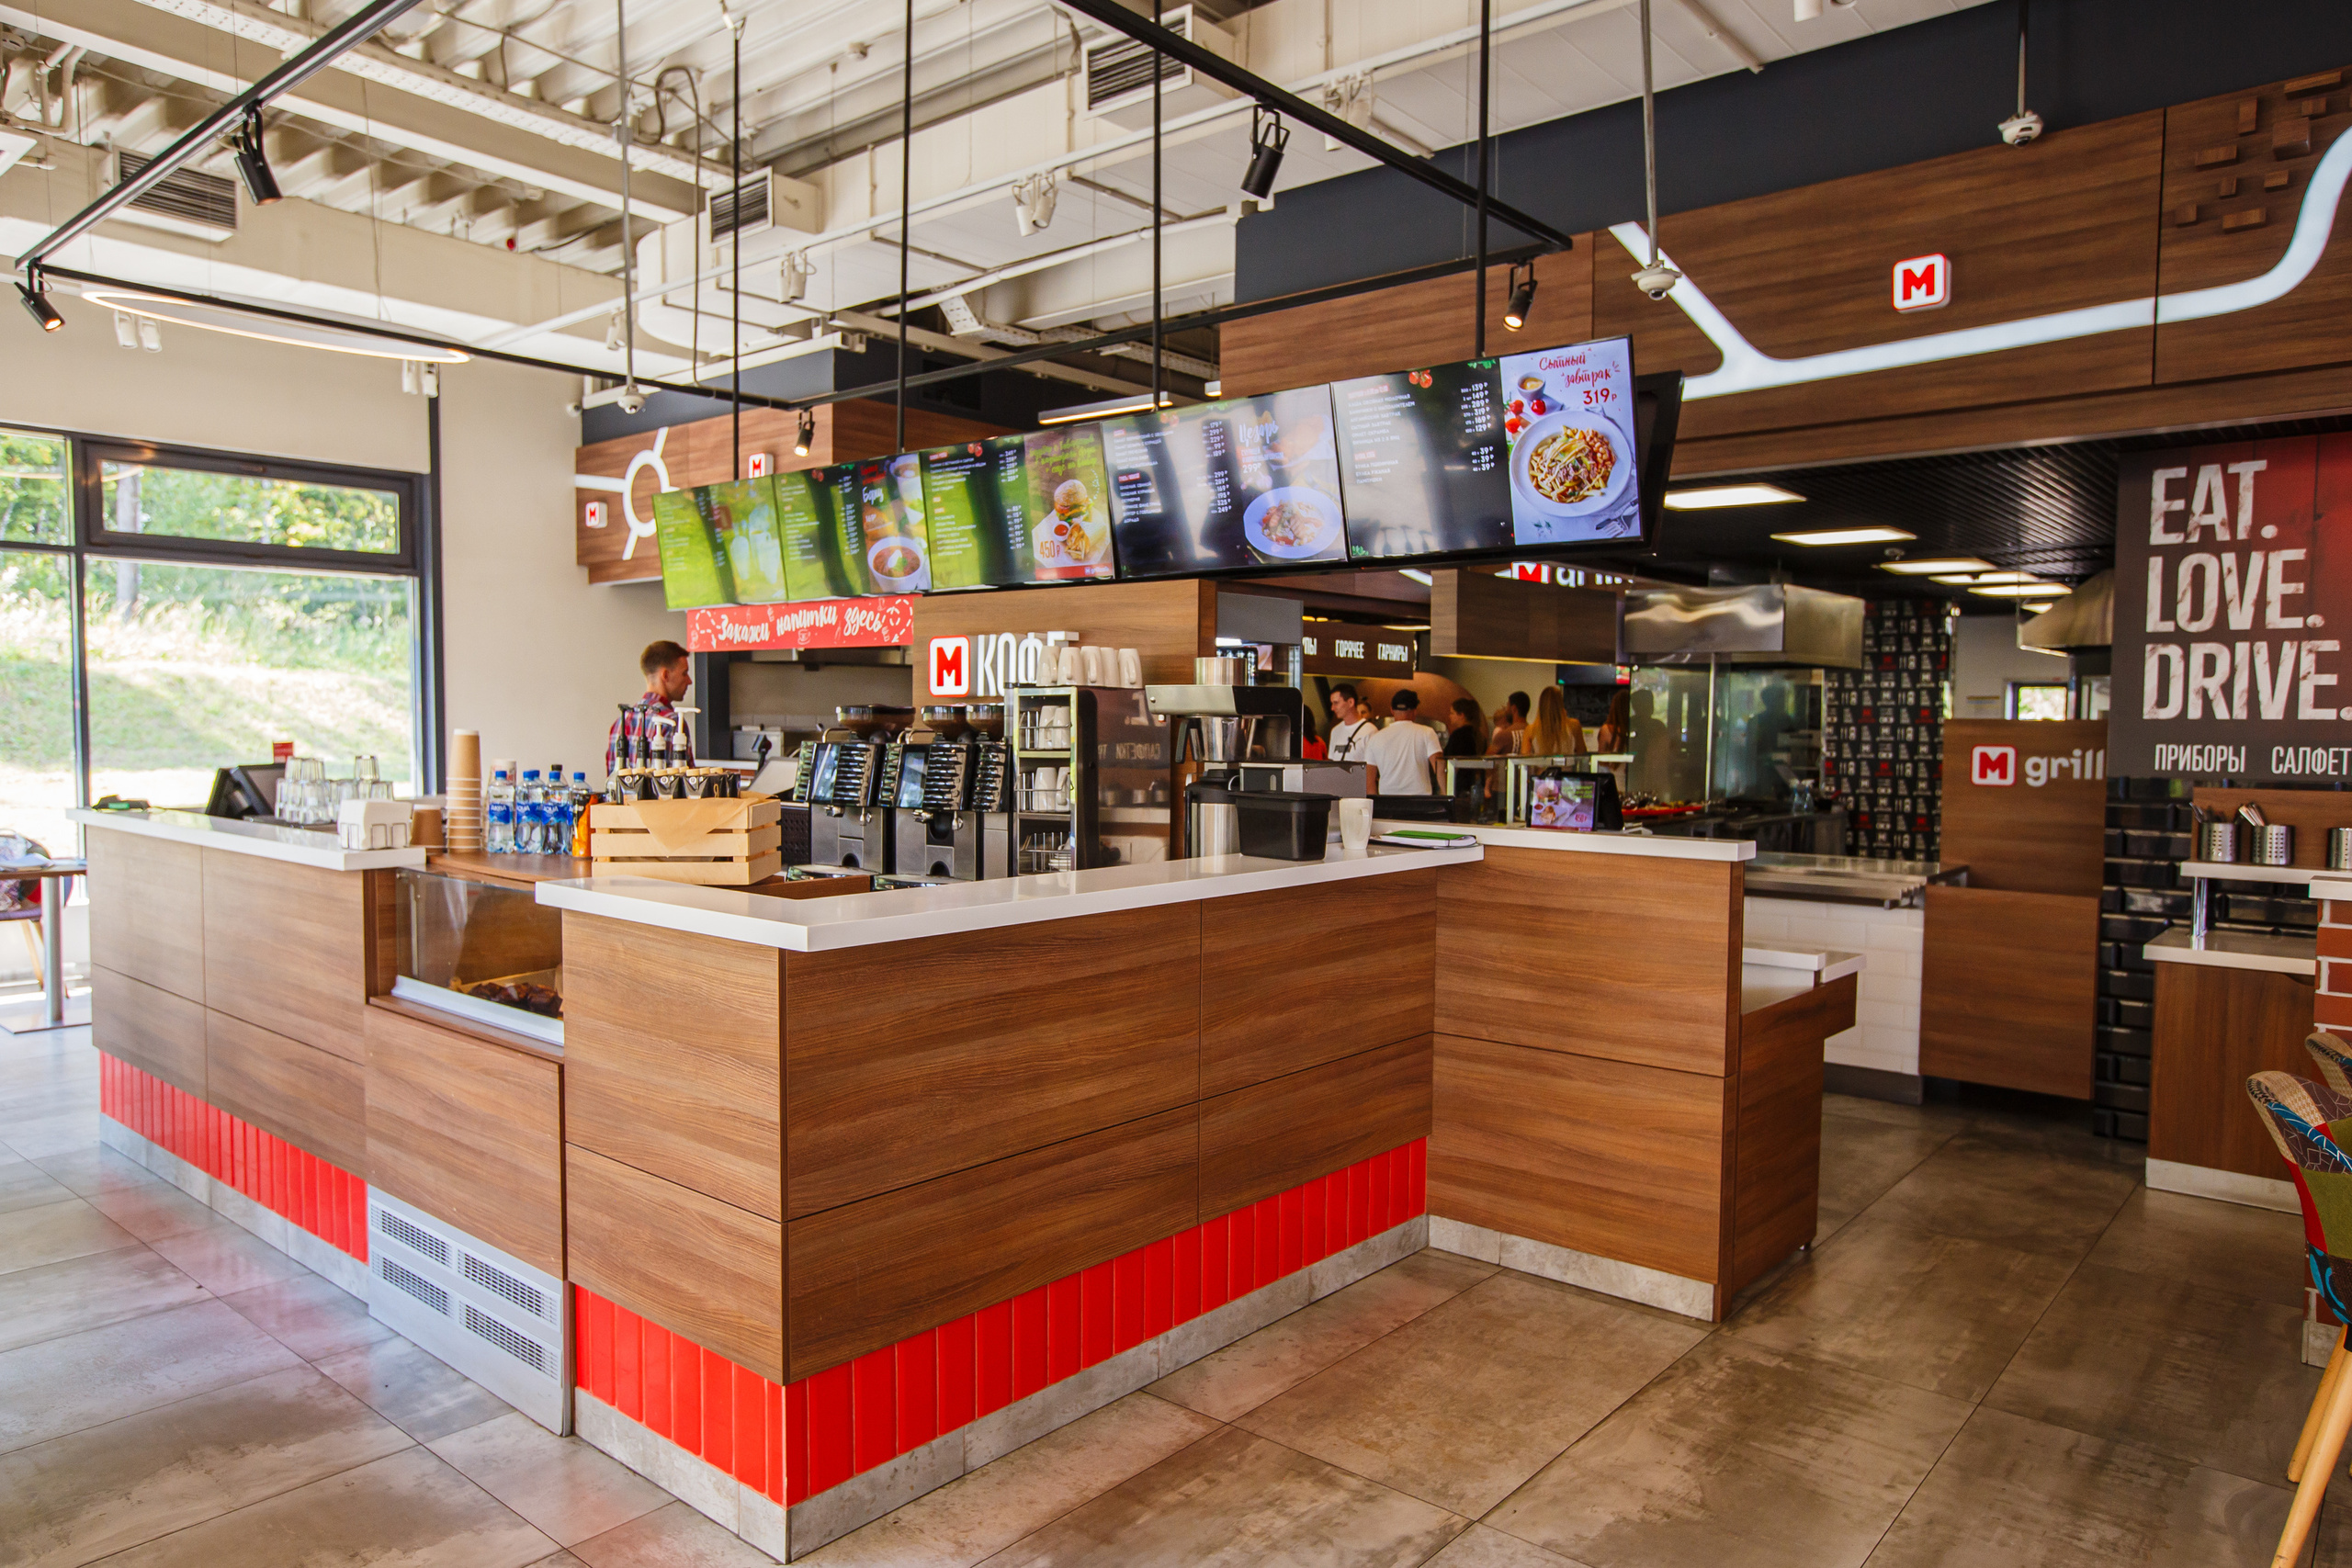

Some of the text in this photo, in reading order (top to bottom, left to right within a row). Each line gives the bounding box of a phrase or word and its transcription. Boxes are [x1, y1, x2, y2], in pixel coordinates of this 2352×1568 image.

[1539, 352, 1586, 371] Сытный
[1565, 367, 1611, 388] завтрак
[1238, 420, 1279, 447] Цезарь
[2149, 459, 2278, 546] EAT.
[2145, 548, 2326, 633] LOVE.
[718, 614, 771, 644] Закажи
[776, 605, 839, 637] напитки
[977, 631, 1067, 697] КОФ
[1335, 639, 1364, 659] ГОРЯЧЕЕ
[1377, 643, 1408, 662] ГАРНИРЫ
[2143, 640, 2352, 720] DRIVE.
[2024, 748, 2104, 787] grill
[2154, 744, 2352, 775] ПРИБОРЫ САЛФЕТ
